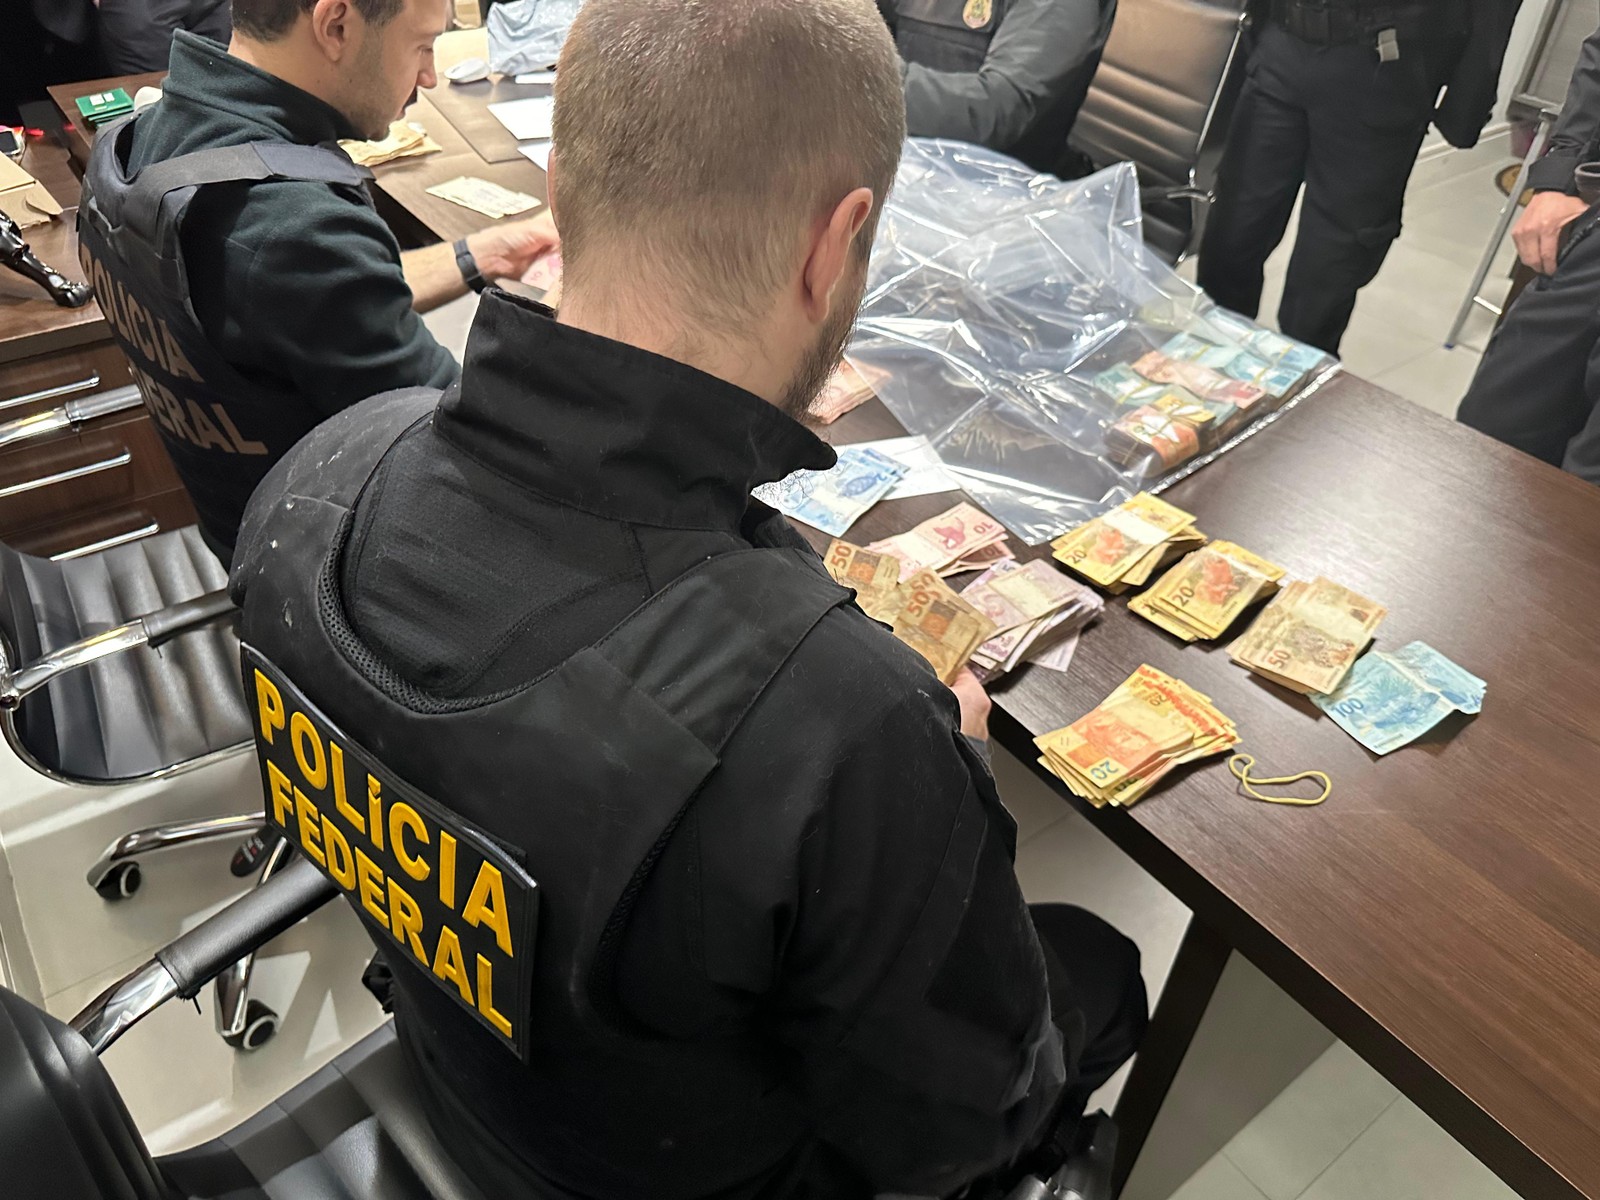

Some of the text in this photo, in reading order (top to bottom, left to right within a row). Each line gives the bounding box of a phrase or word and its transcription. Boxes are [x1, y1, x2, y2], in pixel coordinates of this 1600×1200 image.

[972, 521, 993, 535] 10
[830, 545, 853, 570] 50
[1065, 551, 1088, 565] 20
[907, 590, 931, 618] 50
[1172, 586, 1195, 608] 20
[1267, 649, 1291, 670] 50
[1332, 697, 1365, 718] 100
[1090, 760, 1119, 780] 20
[254, 667, 515, 958] POLÍCIA
[267, 759, 513, 1039] FEDERAL
